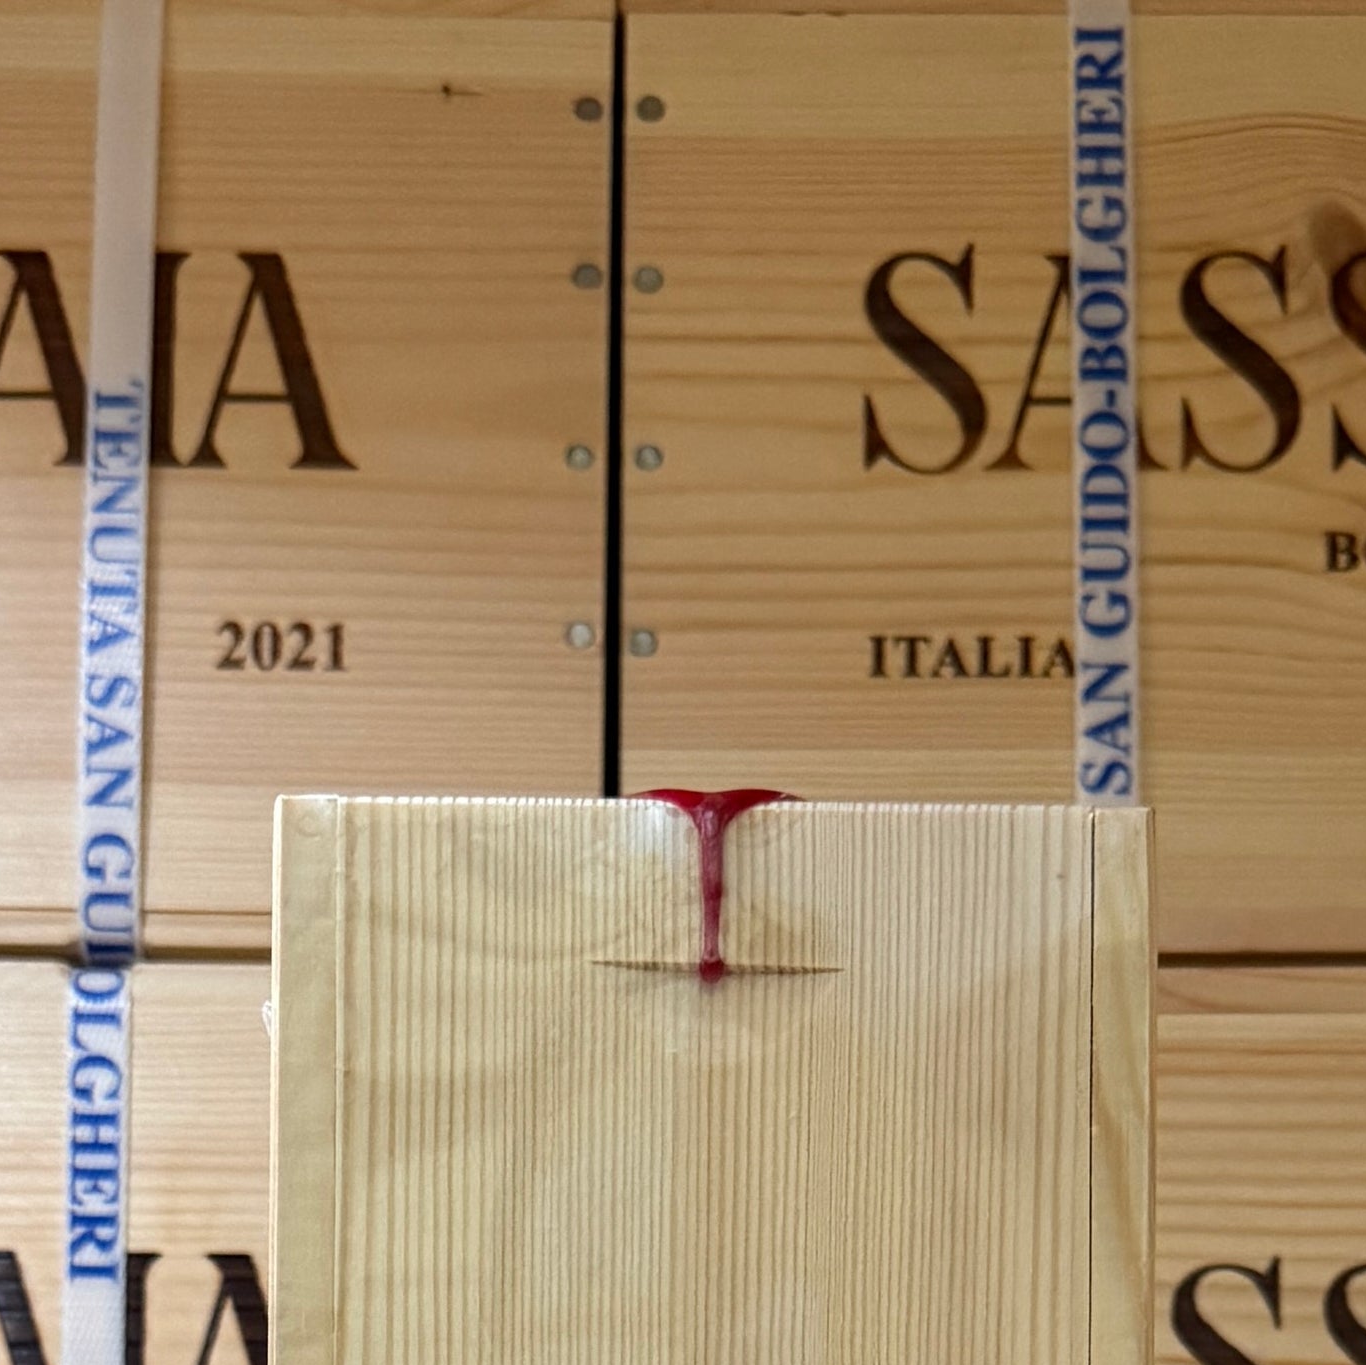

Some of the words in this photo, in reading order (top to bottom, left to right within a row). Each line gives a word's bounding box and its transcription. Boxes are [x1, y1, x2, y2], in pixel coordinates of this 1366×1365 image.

[1074, 26, 1132, 639] GUIDO-BOLGHERI
[84, 378, 143, 656] TENUTA
[216, 621, 349, 672] 2021
[82, 672, 137, 813] SAN
[1080, 660, 1133, 796] SAN
